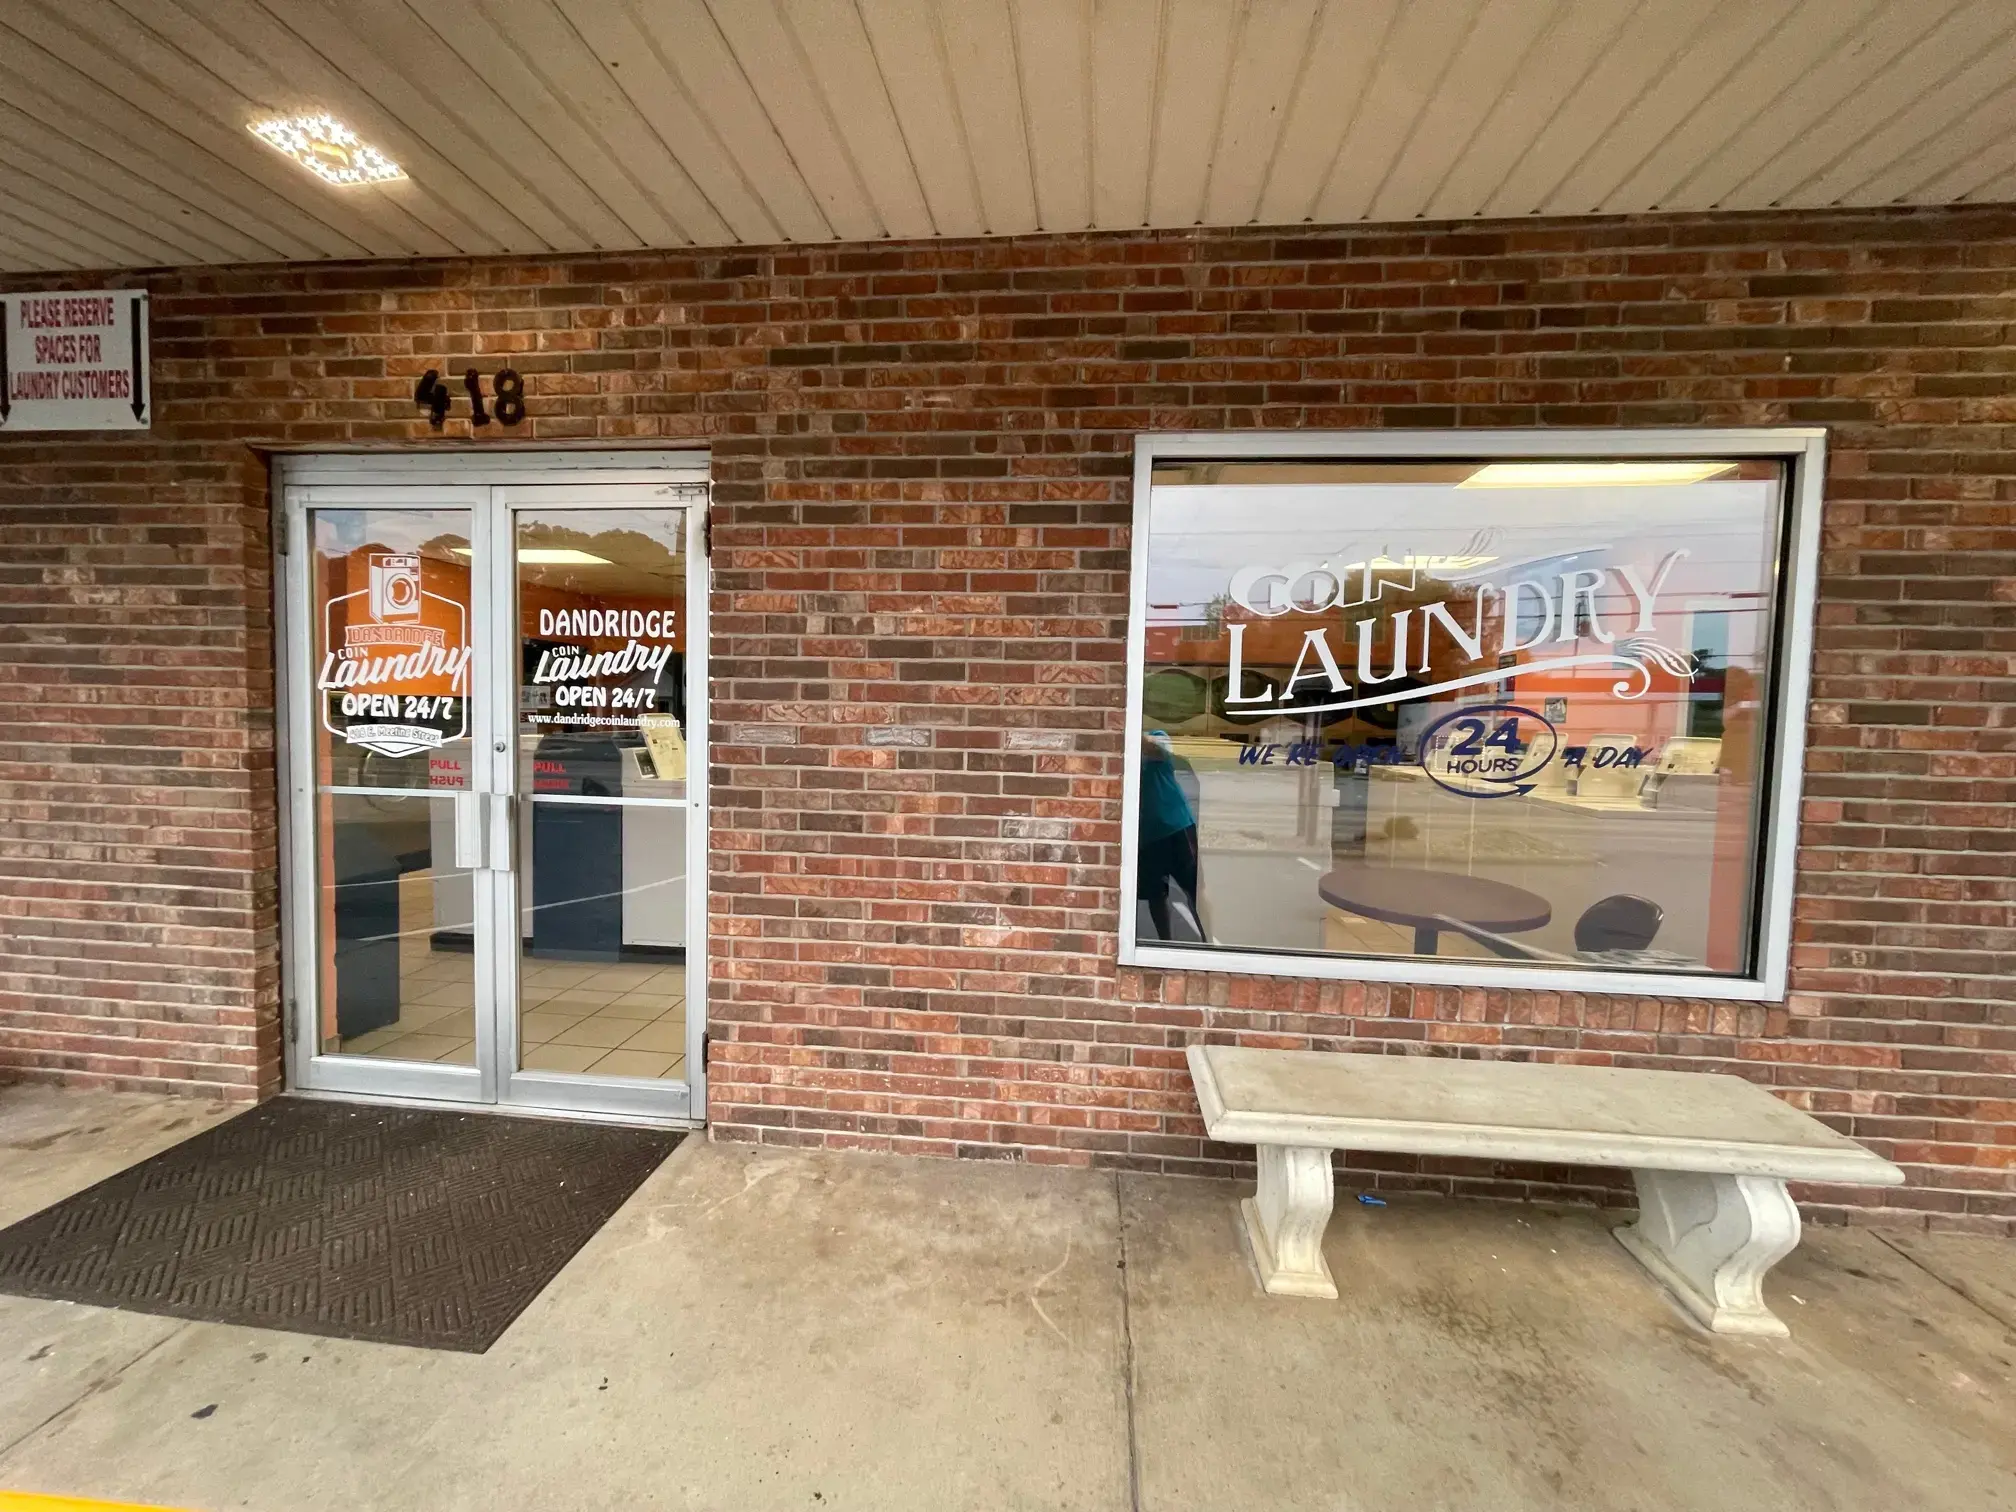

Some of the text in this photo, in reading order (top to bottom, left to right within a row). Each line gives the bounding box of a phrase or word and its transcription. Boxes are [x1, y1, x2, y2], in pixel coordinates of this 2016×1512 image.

[20, 297, 114, 328] PLEASE RESERVE
[35, 335, 101, 364] SPACES FOR
[10, 370, 129, 400] LAUNDRY CUSTOMERS
[414, 368, 525, 431] 418
[1229, 547, 1417, 616] COIN
[351, 627, 442, 646] DANDRIDGE
[539, 608, 676, 638] DANDRIDGE
[1224, 548, 1692, 705] LAUNDRY
[338, 647, 368, 660] COIN
[533, 640, 673, 685] Laundry
[552, 645, 580, 658] COIN
[318, 641, 472, 691] Laundry
[341, 693, 453, 719] OPEN 24/7
[555, 686, 656, 709] OPEN 24/7
[528, 712, 681, 729] www.dandridgecoinlaundry.com
[1451, 717, 1521, 756] 24
[430, 760, 461, 770] PULL
[534, 762, 566, 773] PULL
[1447, 757, 1520, 774] HOURS
[1593, 746, 1653, 769] DAY
